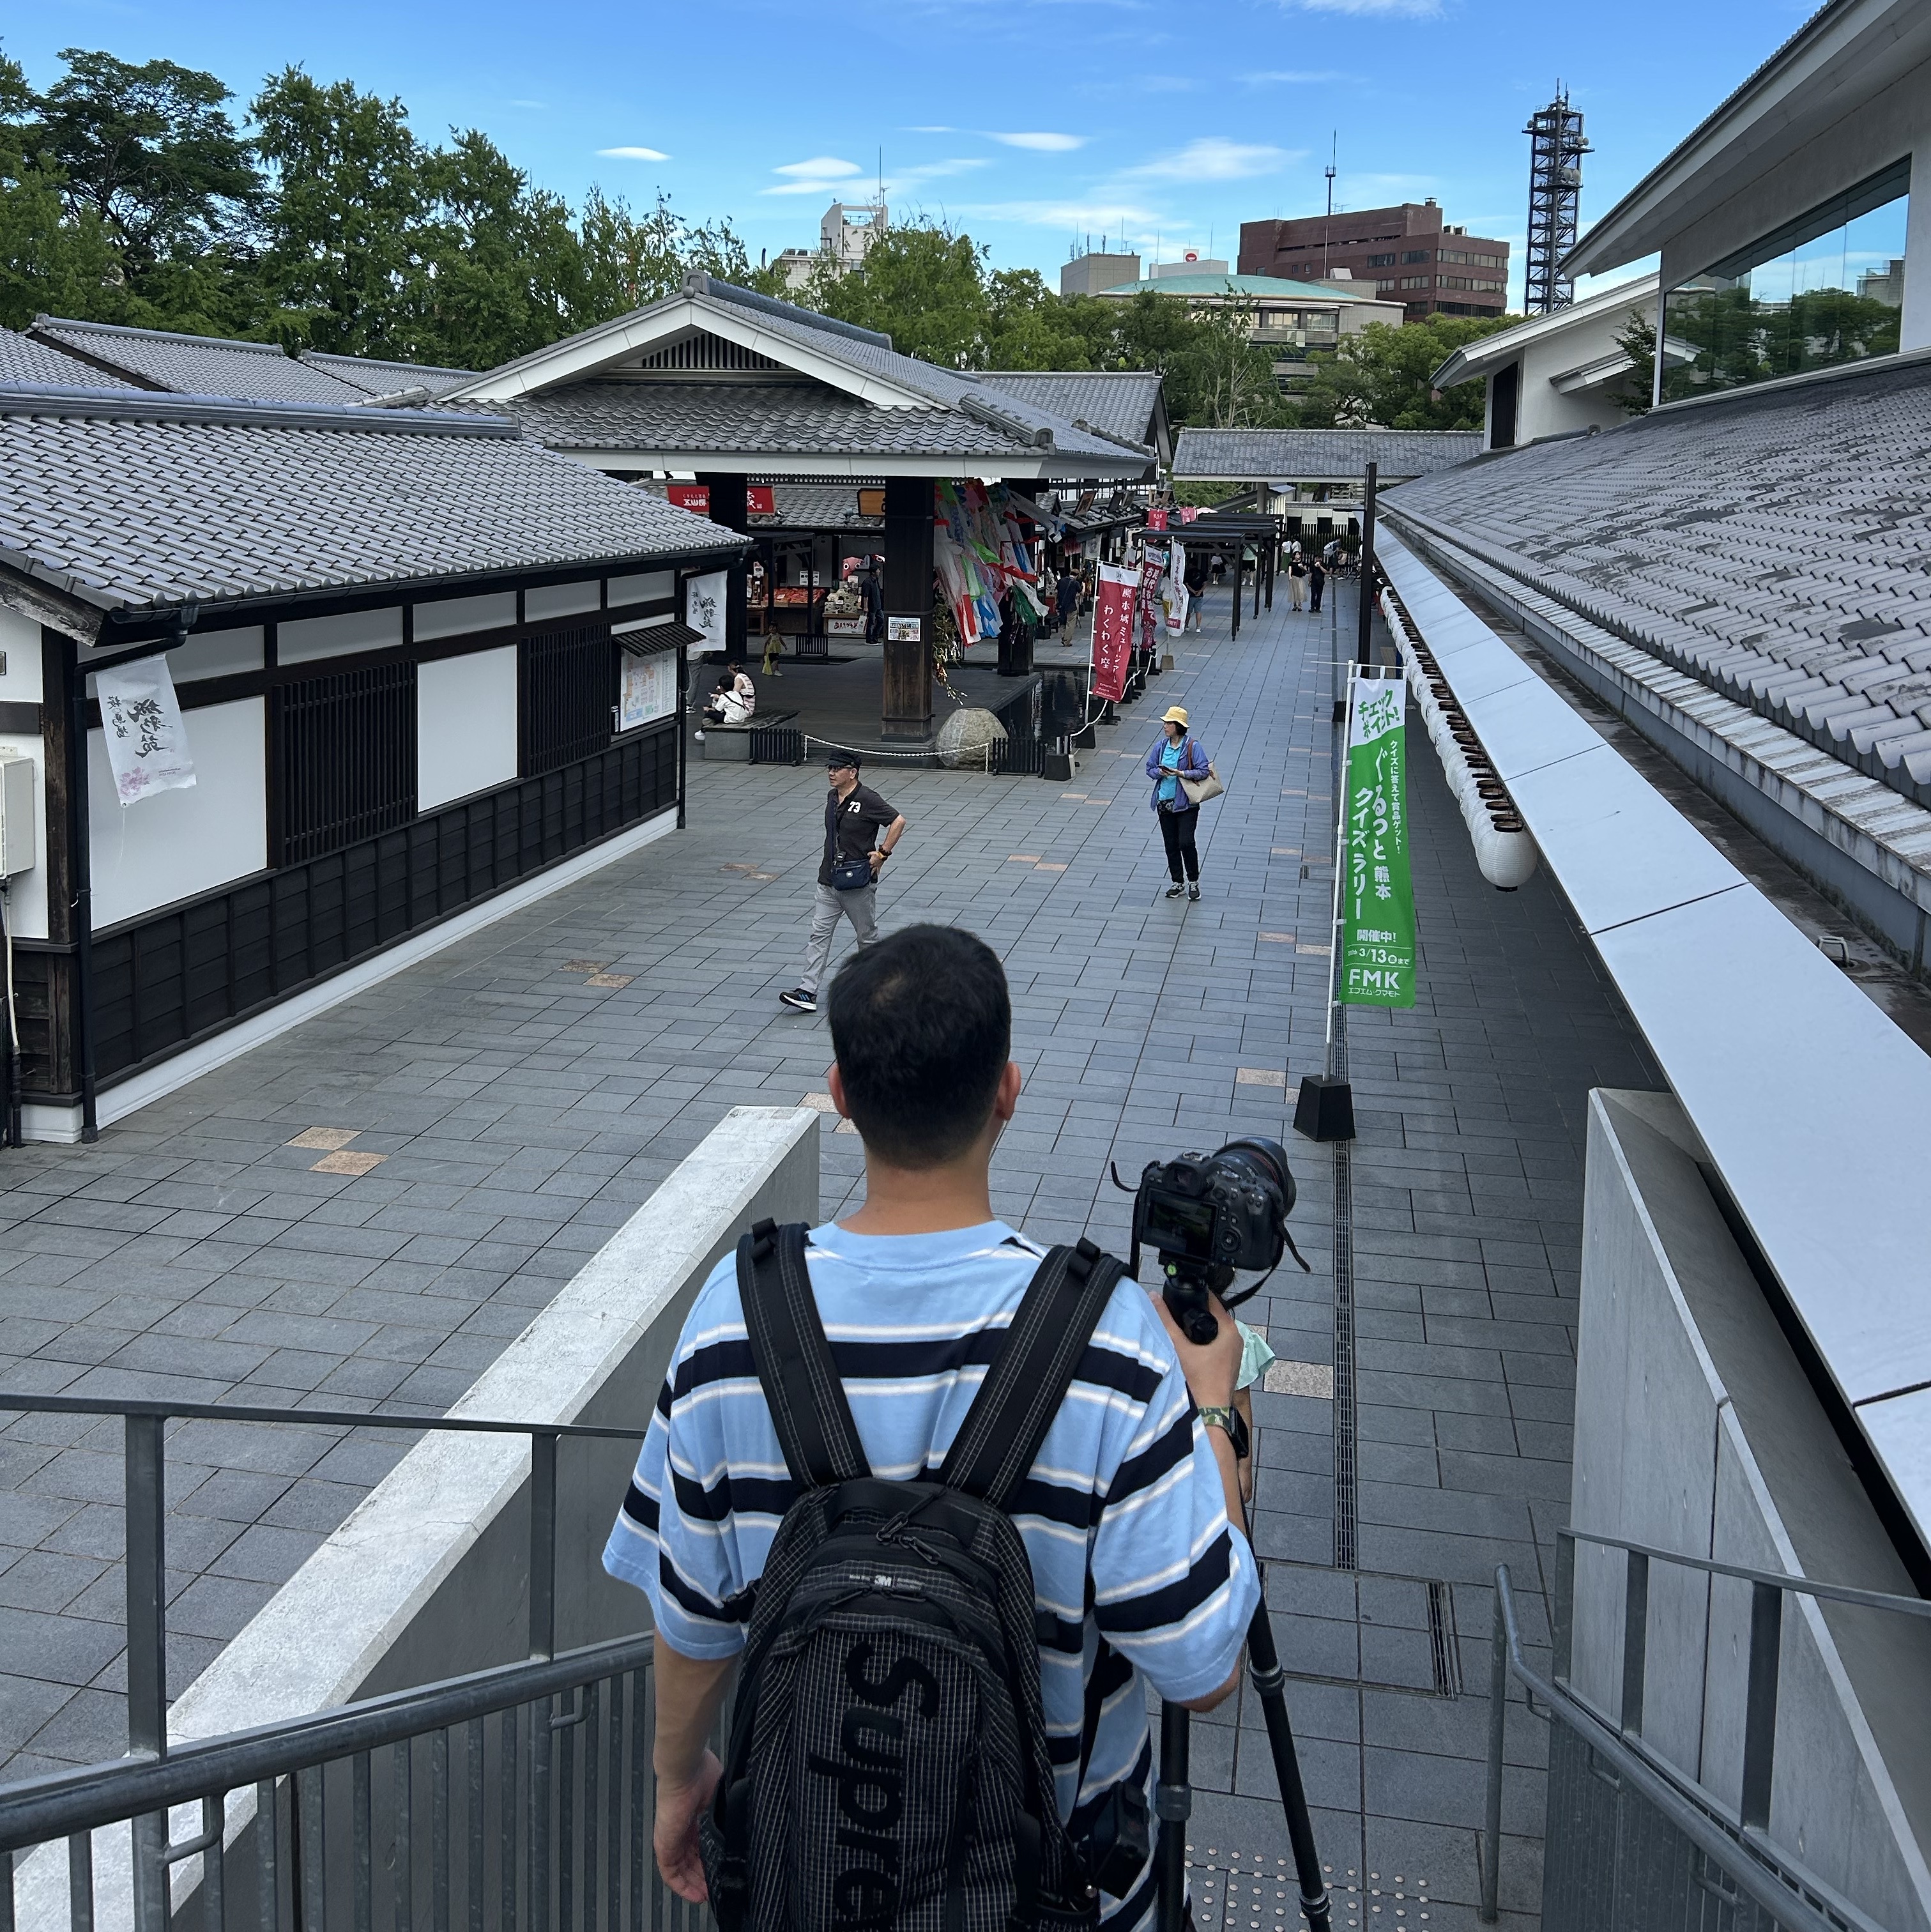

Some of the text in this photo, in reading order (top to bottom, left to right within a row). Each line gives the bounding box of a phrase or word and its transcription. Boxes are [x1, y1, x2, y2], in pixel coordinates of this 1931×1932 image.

[1100, 604, 1113, 670] わくわく座
[1358, 689, 1393, 721] チェック
[847, 801, 861, 813] 73
[1352, 787, 1374, 919] クイズラリー
[1357, 929, 1396, 943] 開催中!
[1348, 969, 1400, 990] FMK
